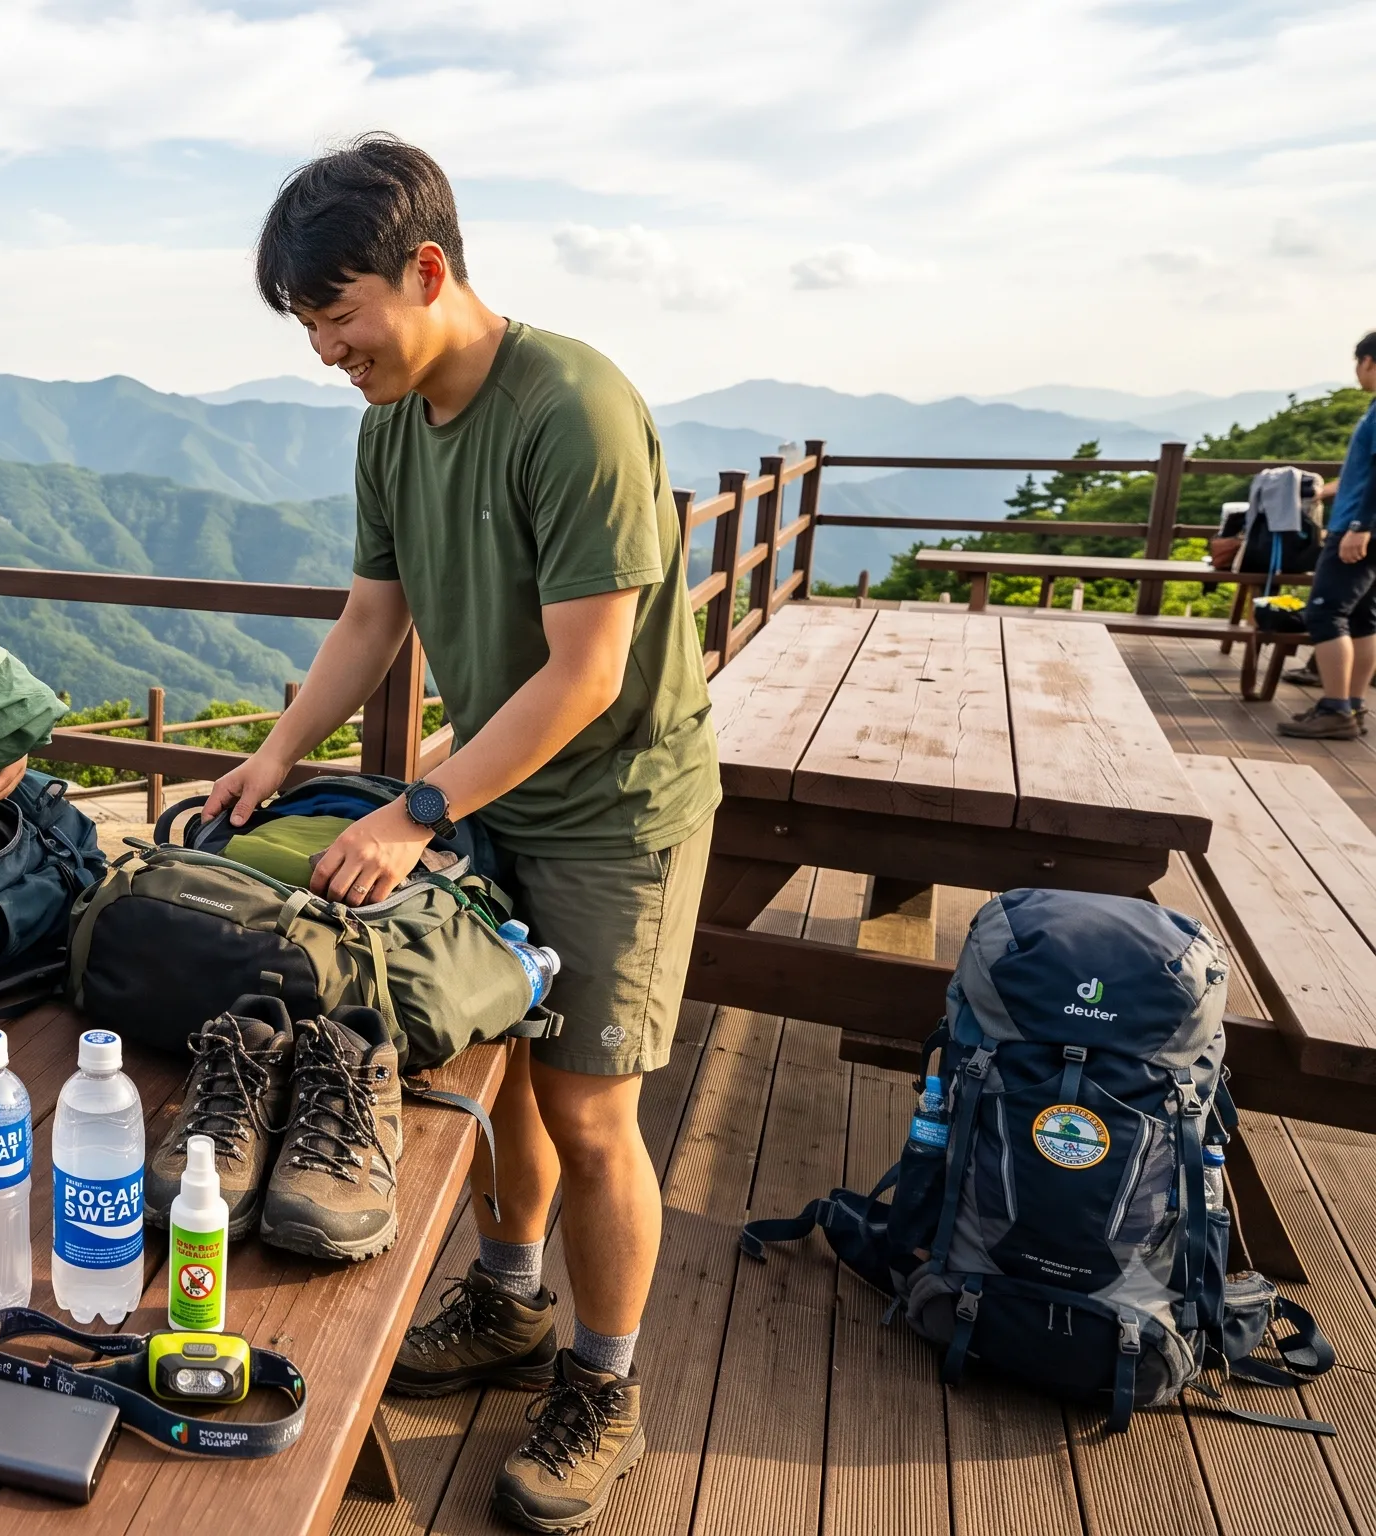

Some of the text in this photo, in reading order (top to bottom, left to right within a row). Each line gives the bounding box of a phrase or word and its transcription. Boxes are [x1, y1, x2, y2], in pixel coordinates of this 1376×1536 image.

[1063, 1003, 1118, 1022] deuter
[65, 1176, 144, 1207] POCARI
[64, 1196, 141, 1222] SWEAT
